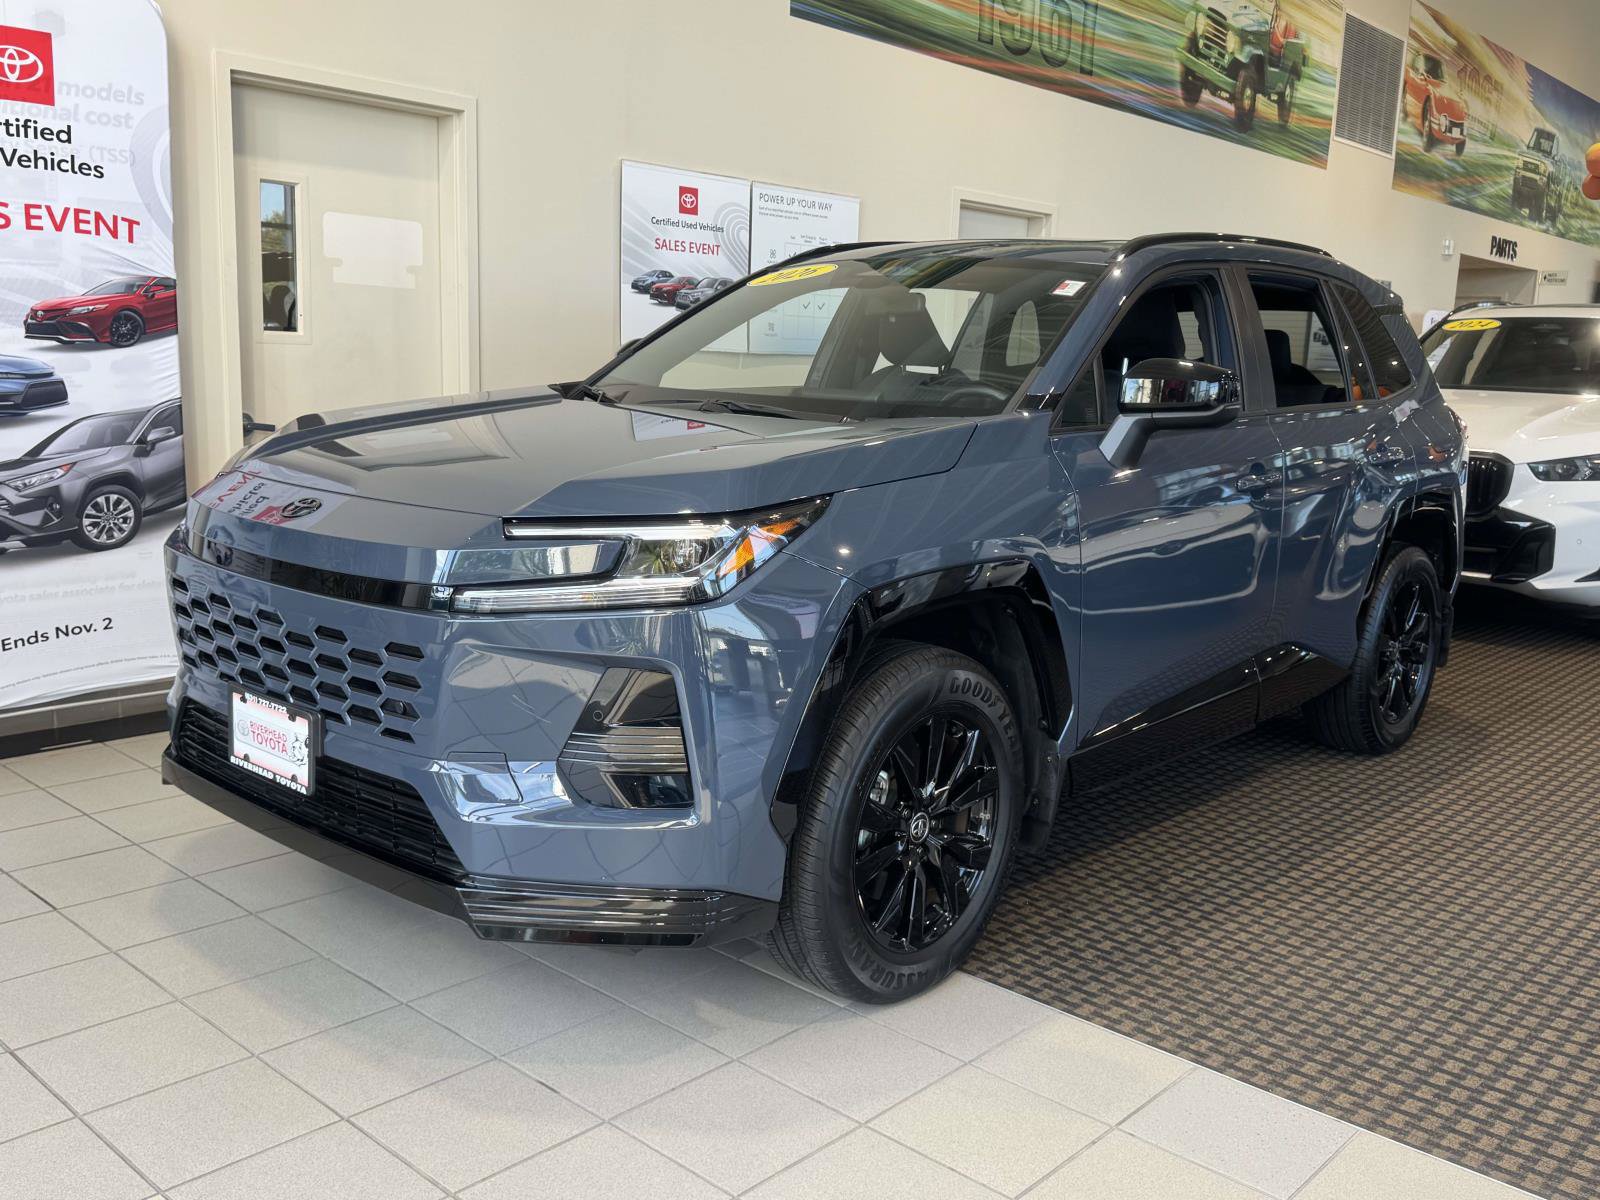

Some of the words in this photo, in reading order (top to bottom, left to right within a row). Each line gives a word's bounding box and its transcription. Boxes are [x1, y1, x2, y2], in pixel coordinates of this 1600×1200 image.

[57, 81, 145, 105] models
[0, 118, 72, 144] tified
[84, 109, 134, 129] cost
[0, 146, 105, 179] Vehicles
[759, 193, 785, 205] POWER
[787, 197, 796, 206] UP
[797, 199, 816, 209] YOUR
[817, 202, 833, 211] WAY
[24, 203, 141, 244] EVENT
[651, 216, 680, 228] Certified
[681, 220, 697, 230] Used
[699, 222, 724, 233] Vehicles
[655, 237, 686, 253] SALES
[689, 241, 721, 256] EVENT
[1490, 235, 1518, 262] PARTS
[1, 630, 50, 651] Ends
[55, 623, 98, 639] Nov.
[102, 617, 114, 631] 2
[250, 730, 289, 756] TOYOTA
[230, 755, 274, 780] RIVERHEAD
[275, 774, 307, 795] TOYOTA
